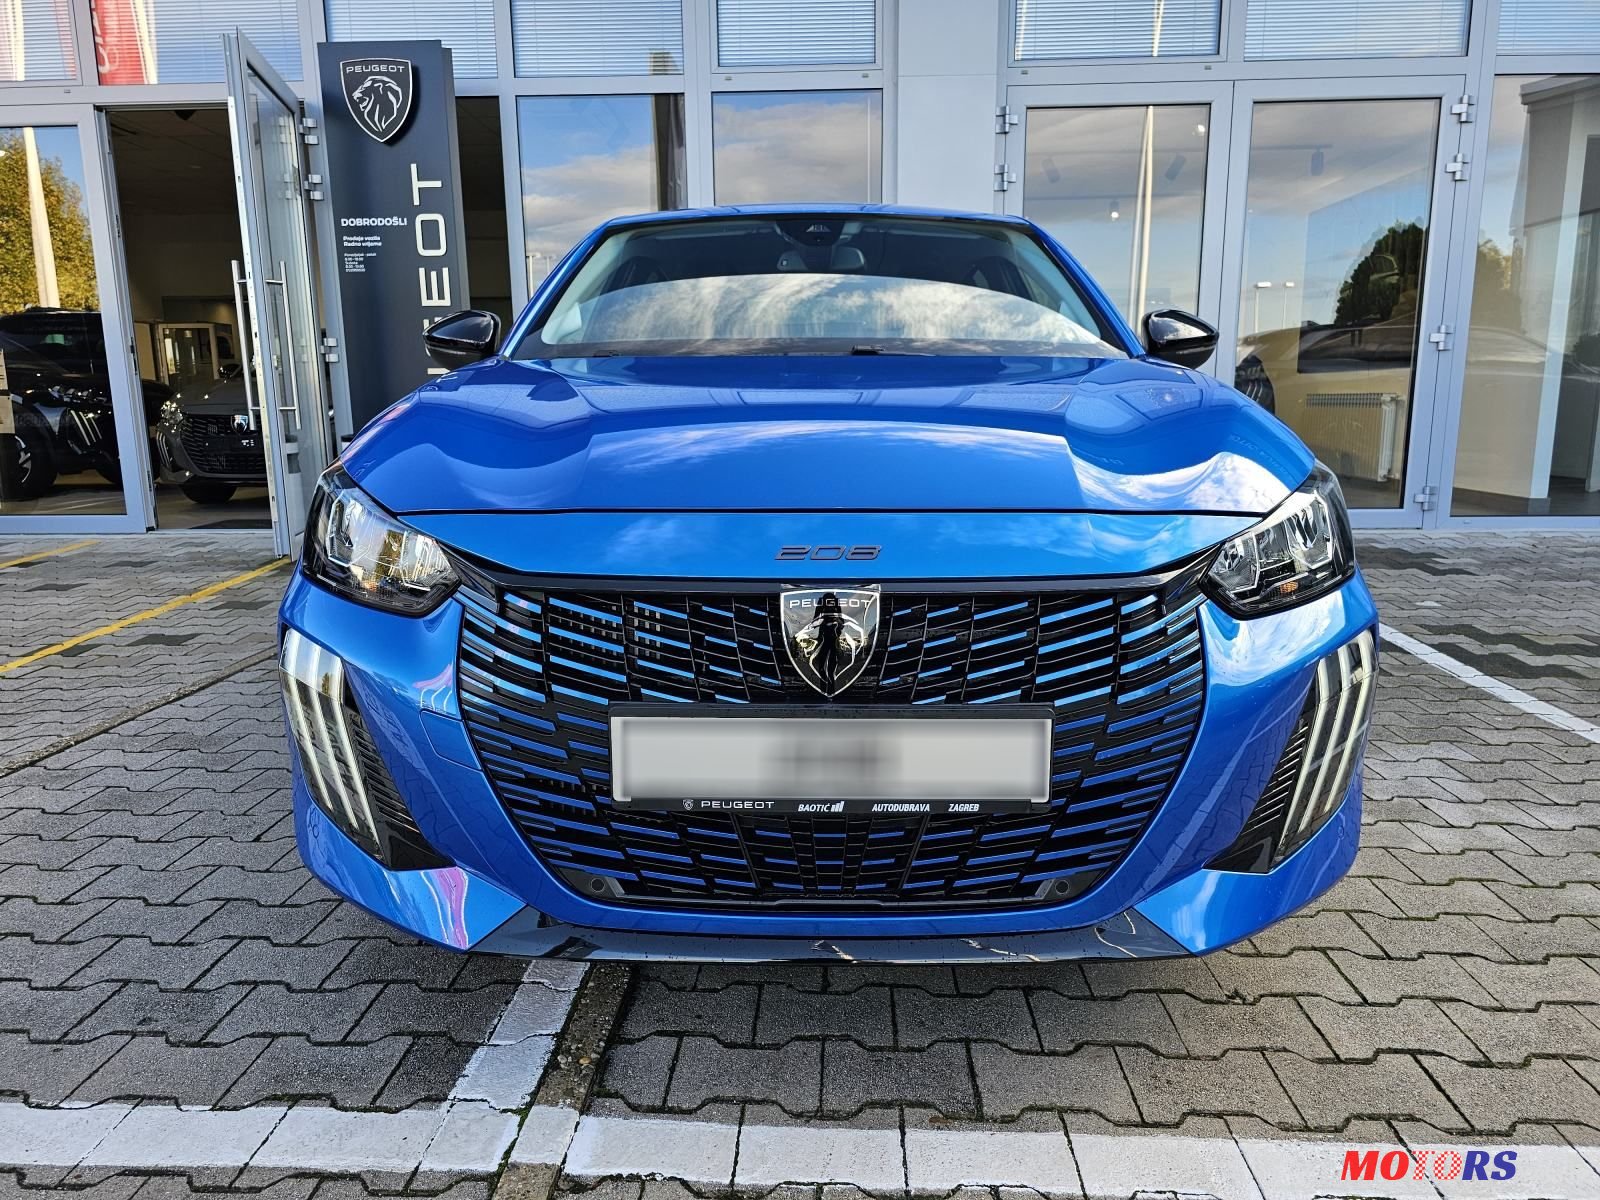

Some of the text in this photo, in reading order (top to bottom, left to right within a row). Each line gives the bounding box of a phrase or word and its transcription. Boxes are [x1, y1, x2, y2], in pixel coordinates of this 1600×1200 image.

[345, 64, 406, 74] PEUGEOT
[341, 216, 407, 226] DOBRODOŠLI
[410, 163, 452, 375] EOT
[775, 545, 881, 560] 208
[789, 598, 871, 608] PEUGEOT
[701, 801, 980, 812] PEUGEOT BAOTIĆ AUTODUBRAVA ZAGREB
